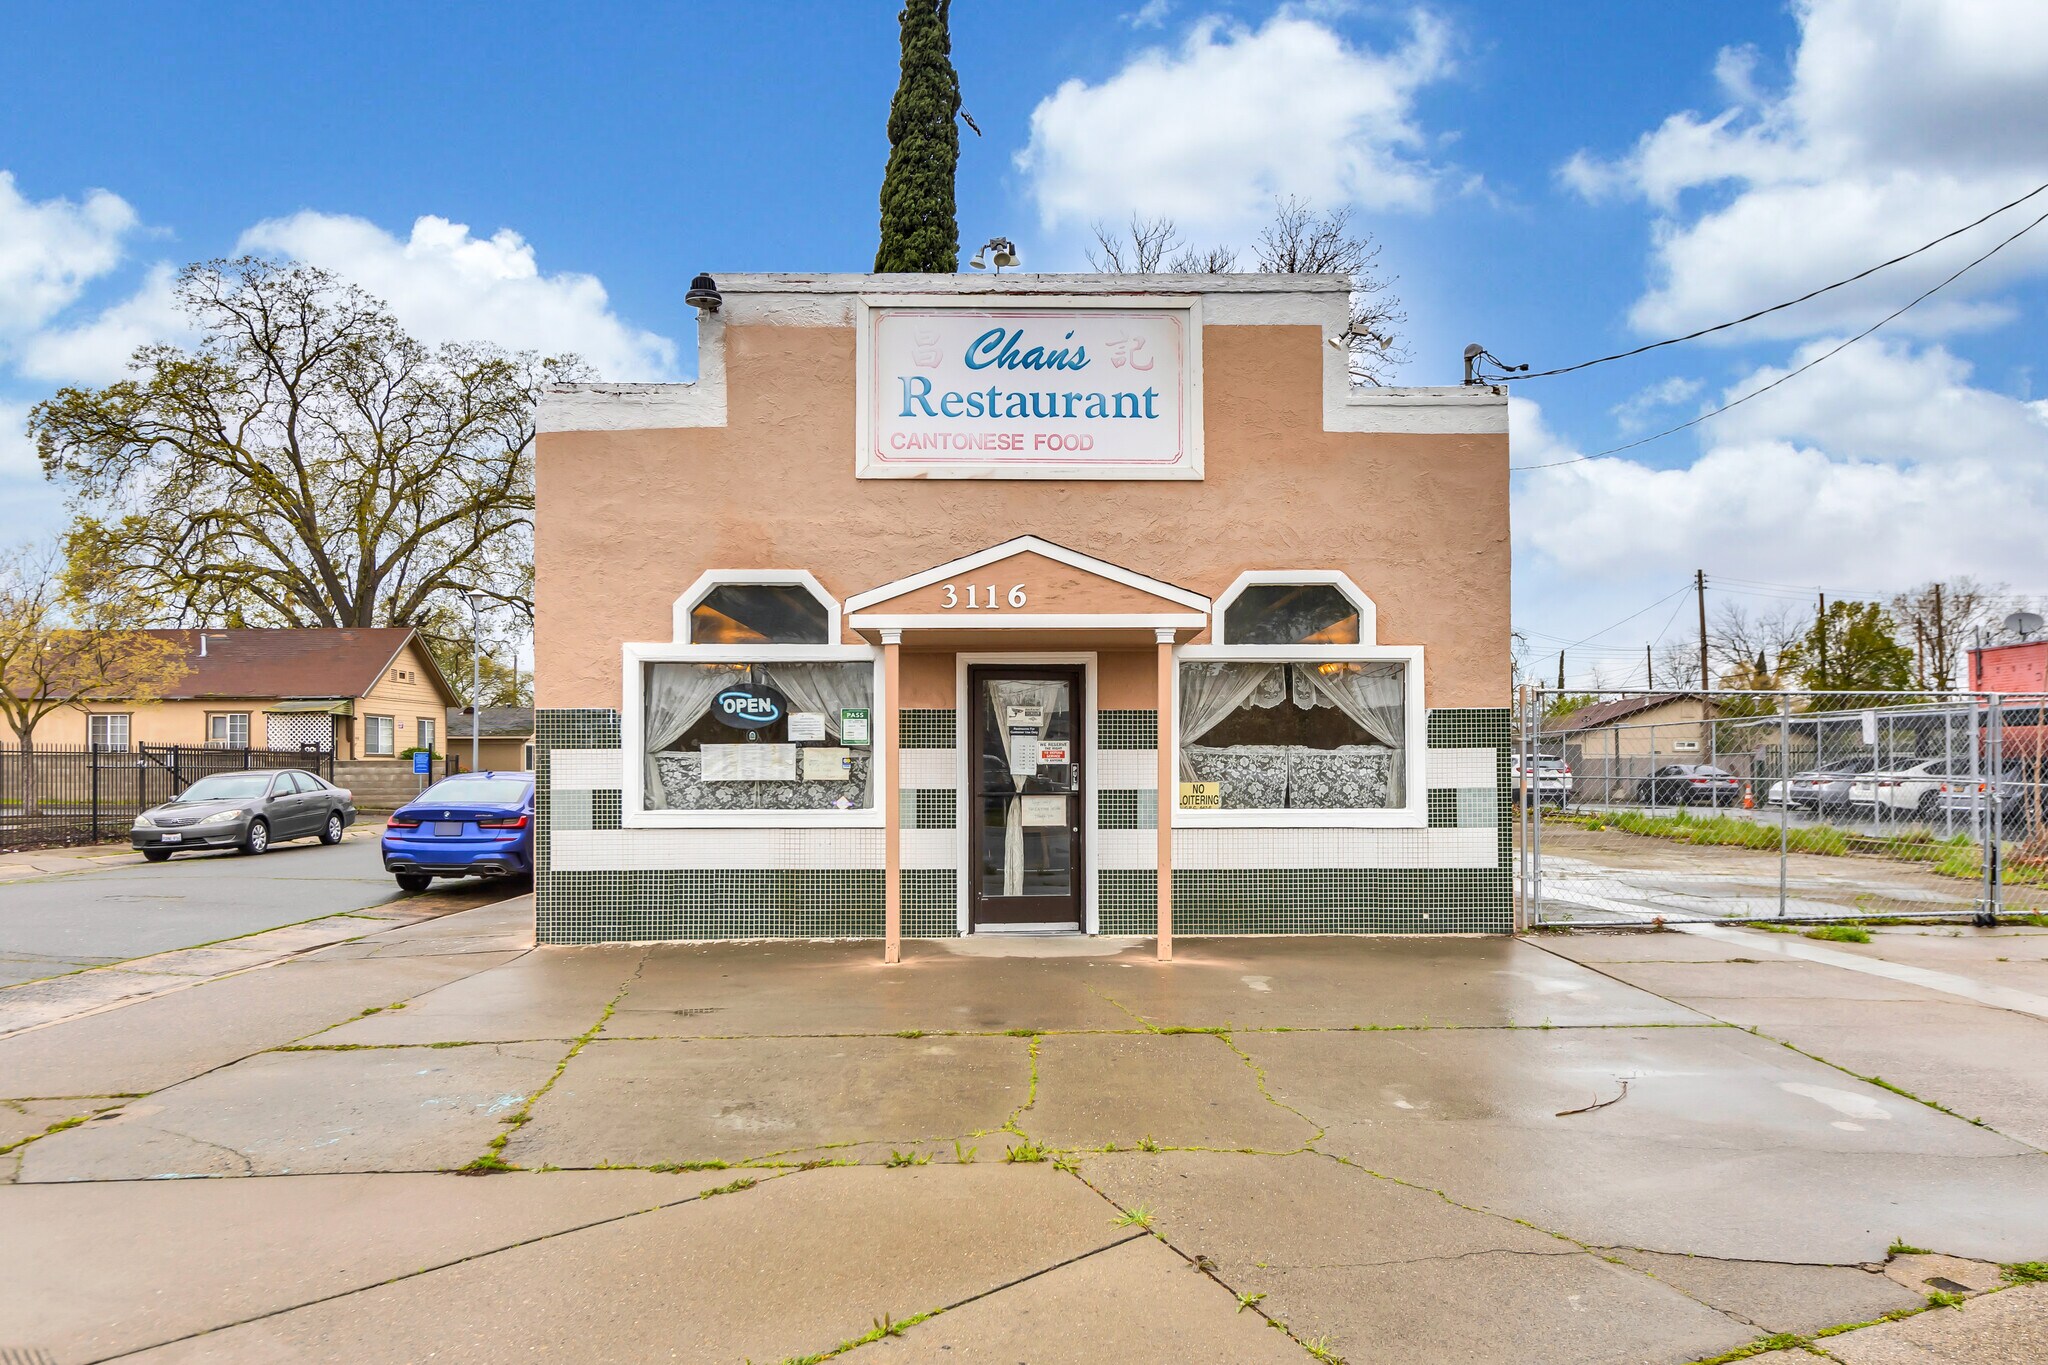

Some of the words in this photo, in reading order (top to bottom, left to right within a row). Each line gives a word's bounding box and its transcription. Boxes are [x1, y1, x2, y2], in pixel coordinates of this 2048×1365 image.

[964, 327, 1091, 371] Chan's
[897, 375, 1160, 419] Restaurant
[890, 432, 1024, 451] CANTONESE
[1034, 433, 1094, 451] FOOD
[941, 583, 1027, 609] 3116
[723, 697, 771, 714] OPEN
[1192, 784, 1205, 794] NO
